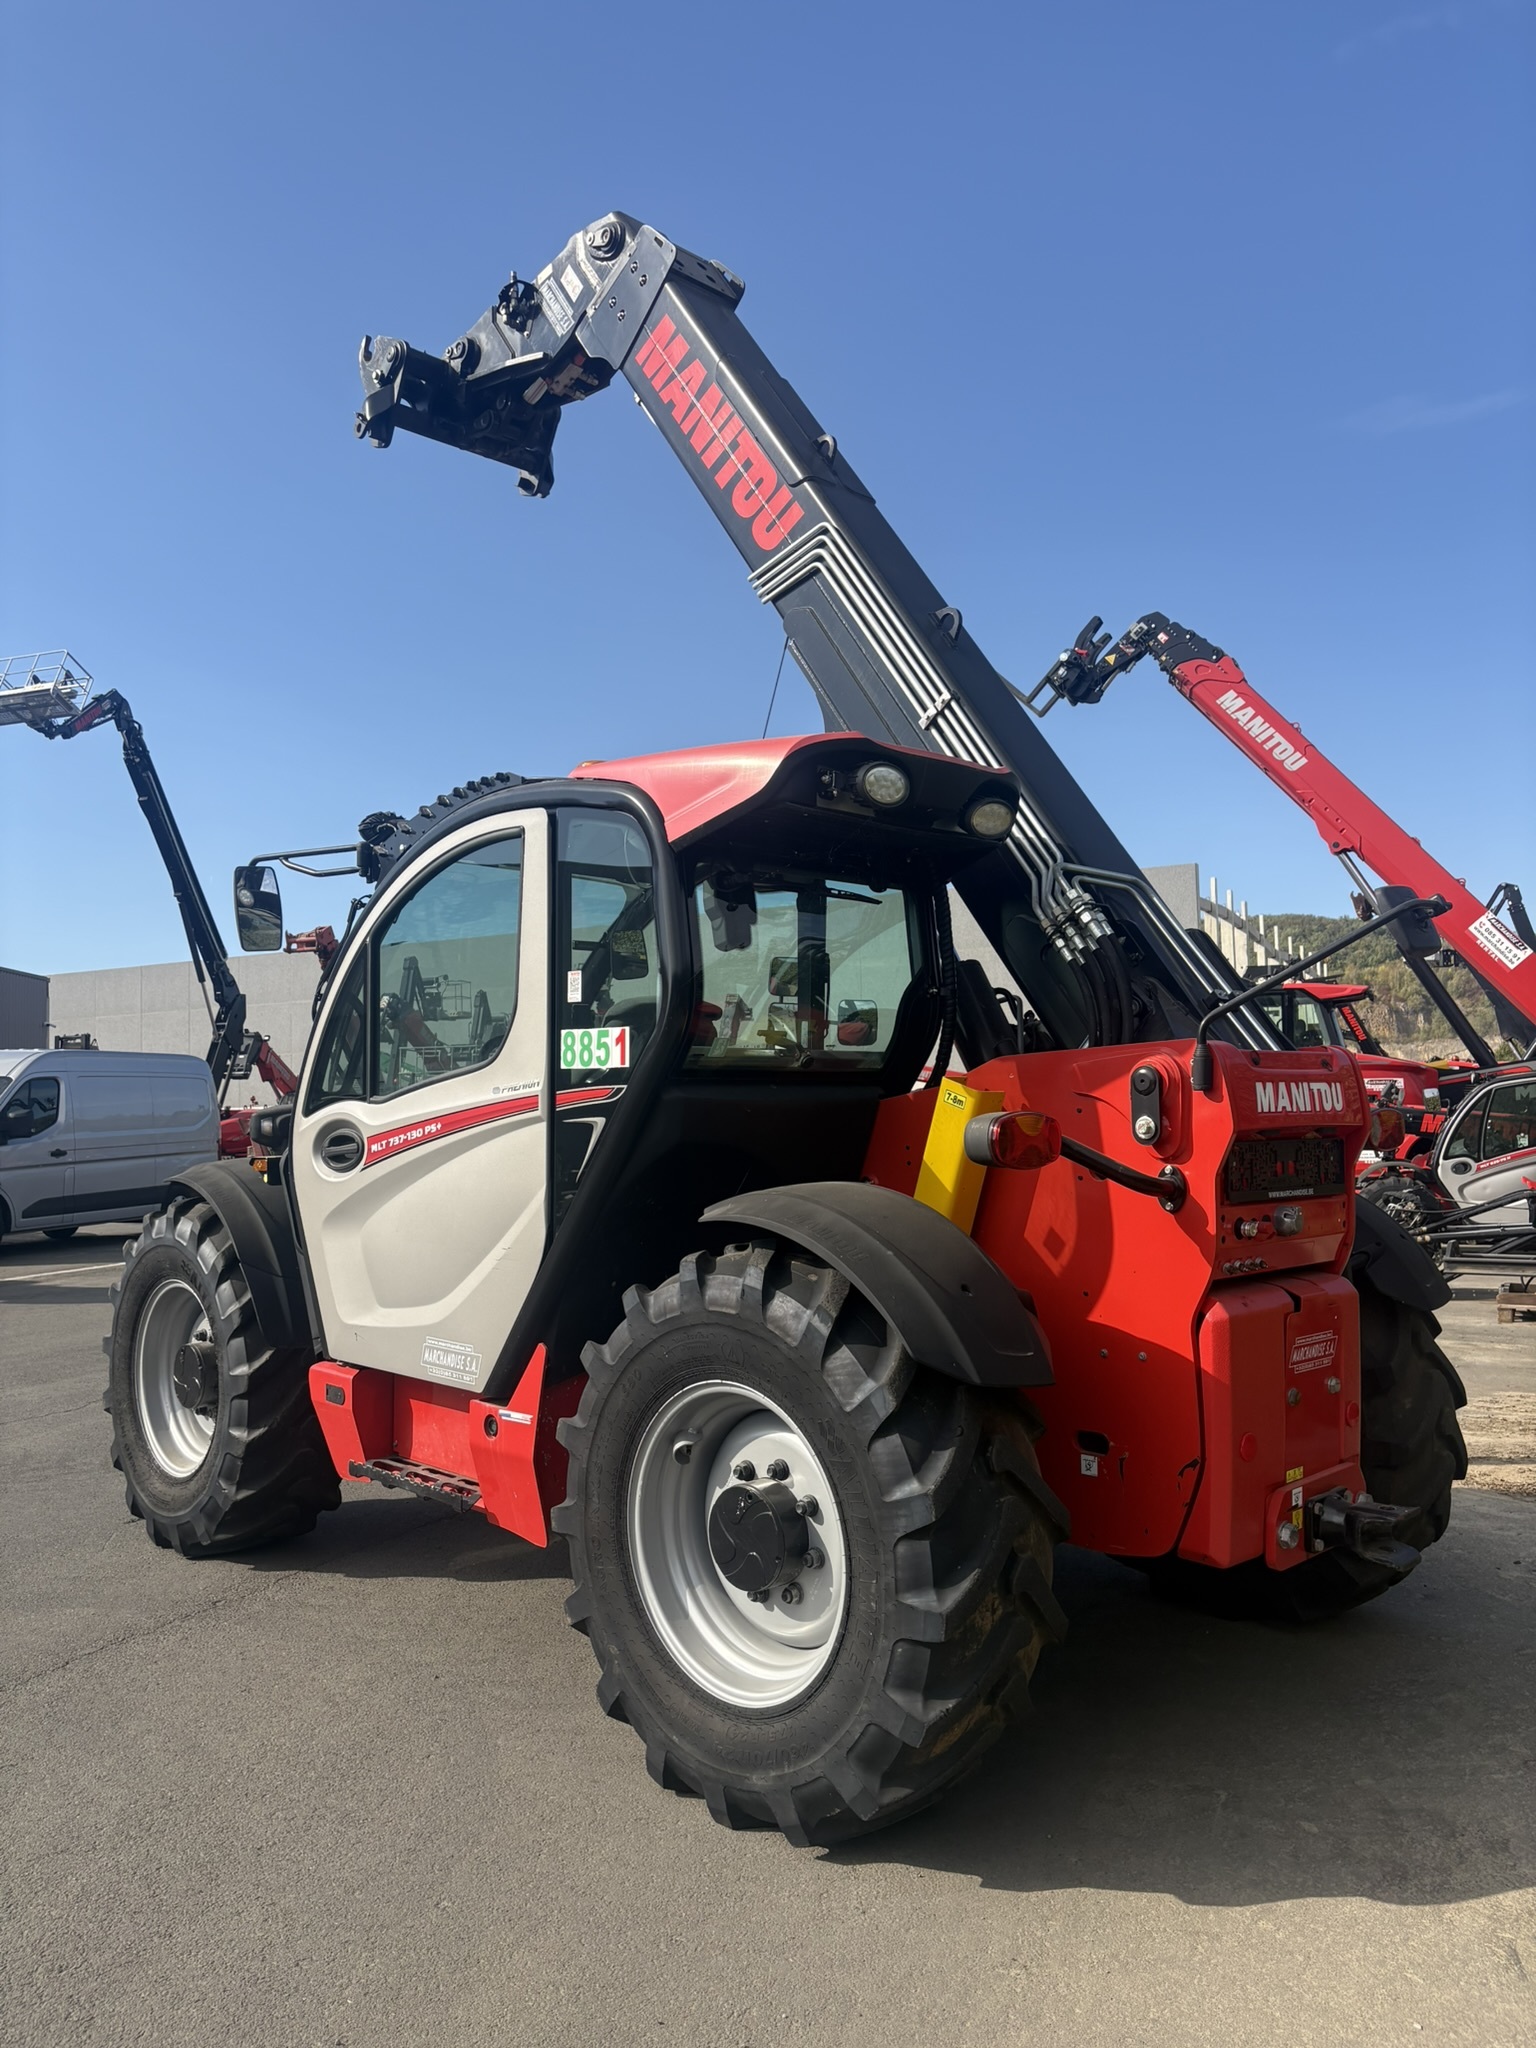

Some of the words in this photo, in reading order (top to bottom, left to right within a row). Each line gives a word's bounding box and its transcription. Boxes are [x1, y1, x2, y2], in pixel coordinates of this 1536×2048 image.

[634, 313, 805, 551] MANITOU
[1215, 689, 1309, 772] MANITOU
[1475, 939, 1499, 962] RENTAL
[1484, 927, 1497, 939] 085
[1496, 937, 1505, 946] 31
[1504, 945, 1513, 954] 15
[1511, 952, 1521, 962] 91
[1341, 1006, 1367, 1041] MANITOU
[562, 1028, 626, 1067] 8851
[946, 1092, 964, 1107] 7-8m
[1255, 1082, 1344, 1113] MANITOU
[370, 1139, 387, 1154] MLT
[388, 1128, 423, 1148] 737-130
[423, 1347, 466, 1370] MARCHANDISE
[1292, 1342, 1327, 1362] MARCHANDISE
